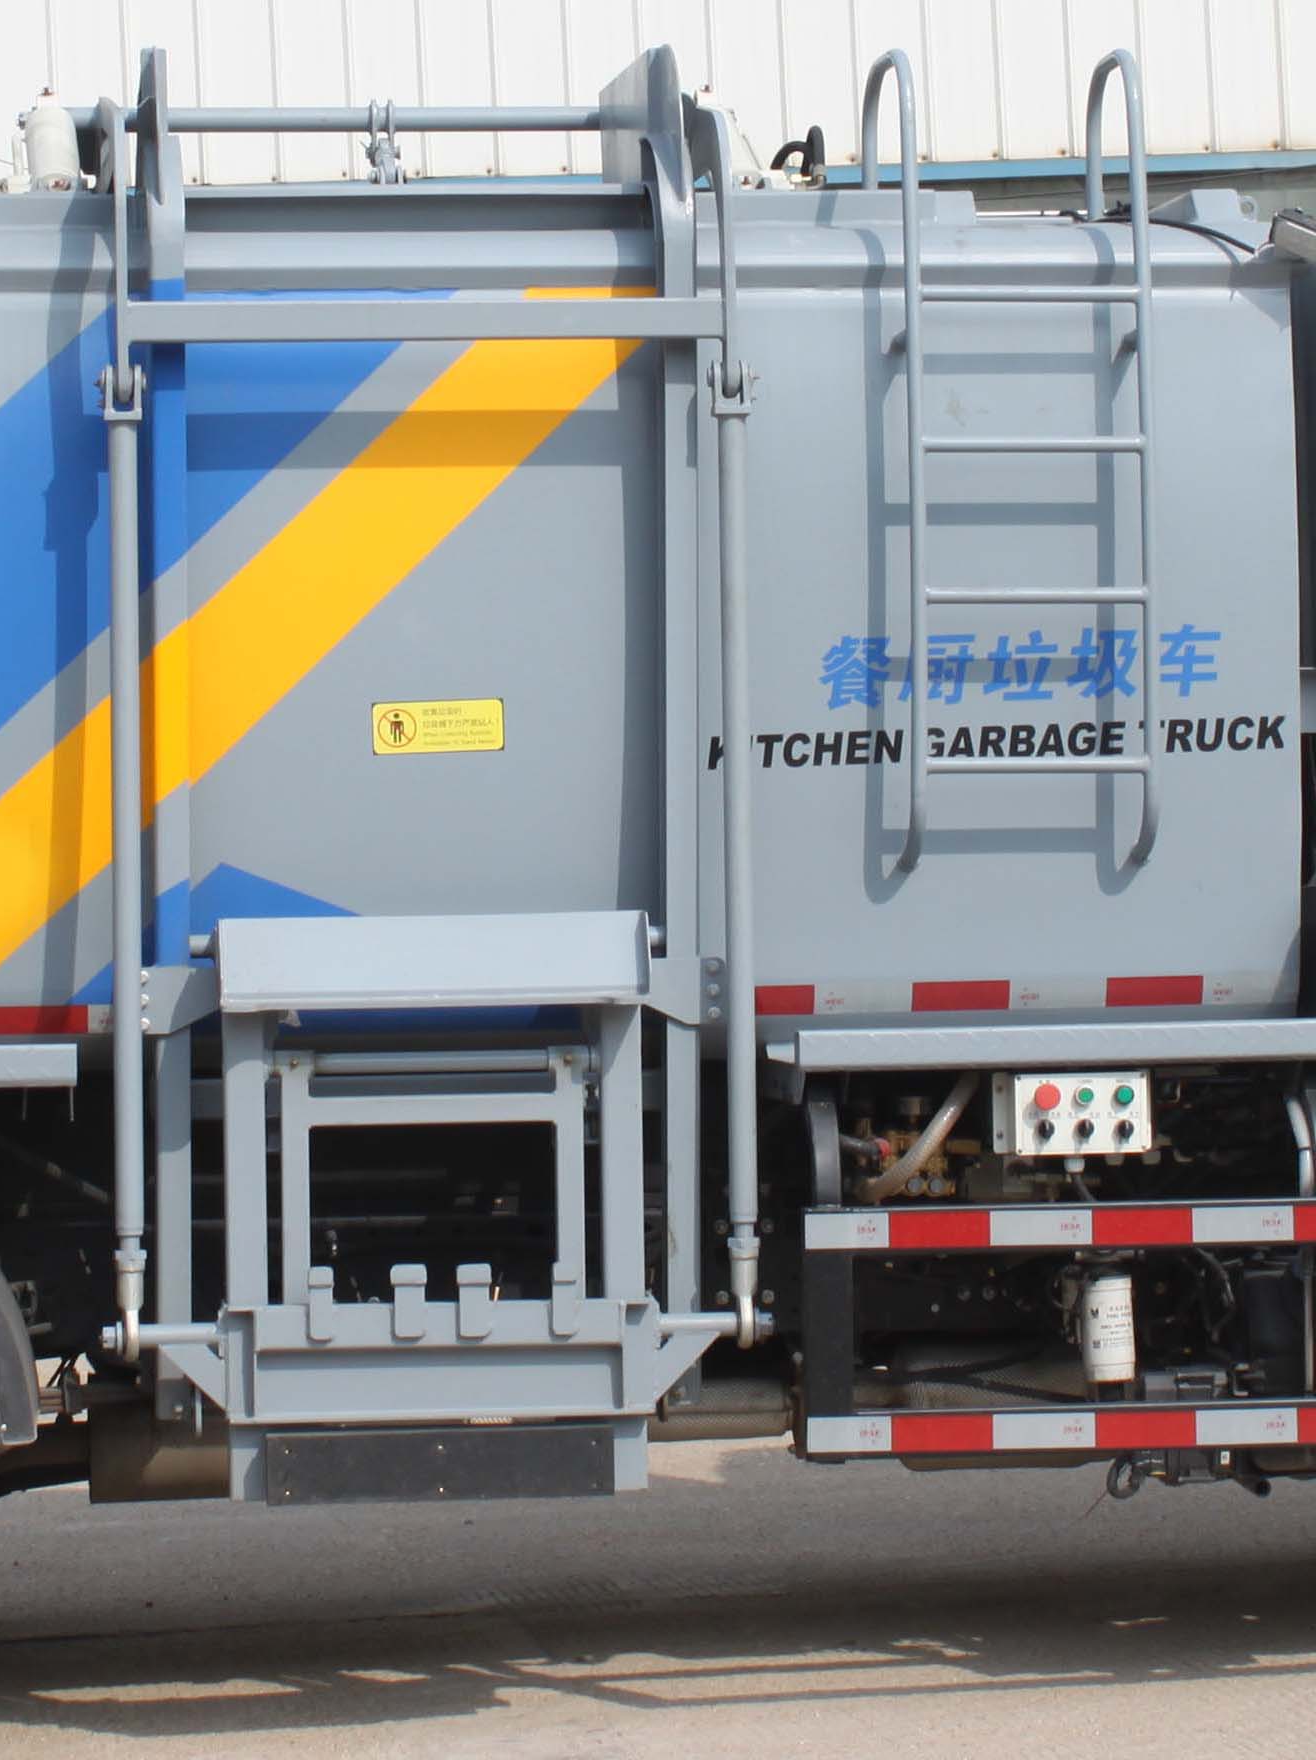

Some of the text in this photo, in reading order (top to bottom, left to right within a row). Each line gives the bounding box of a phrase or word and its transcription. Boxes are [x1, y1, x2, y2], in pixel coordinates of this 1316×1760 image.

[708, 716, 1286, 770] KTCHEN GARBAGE RUCK
